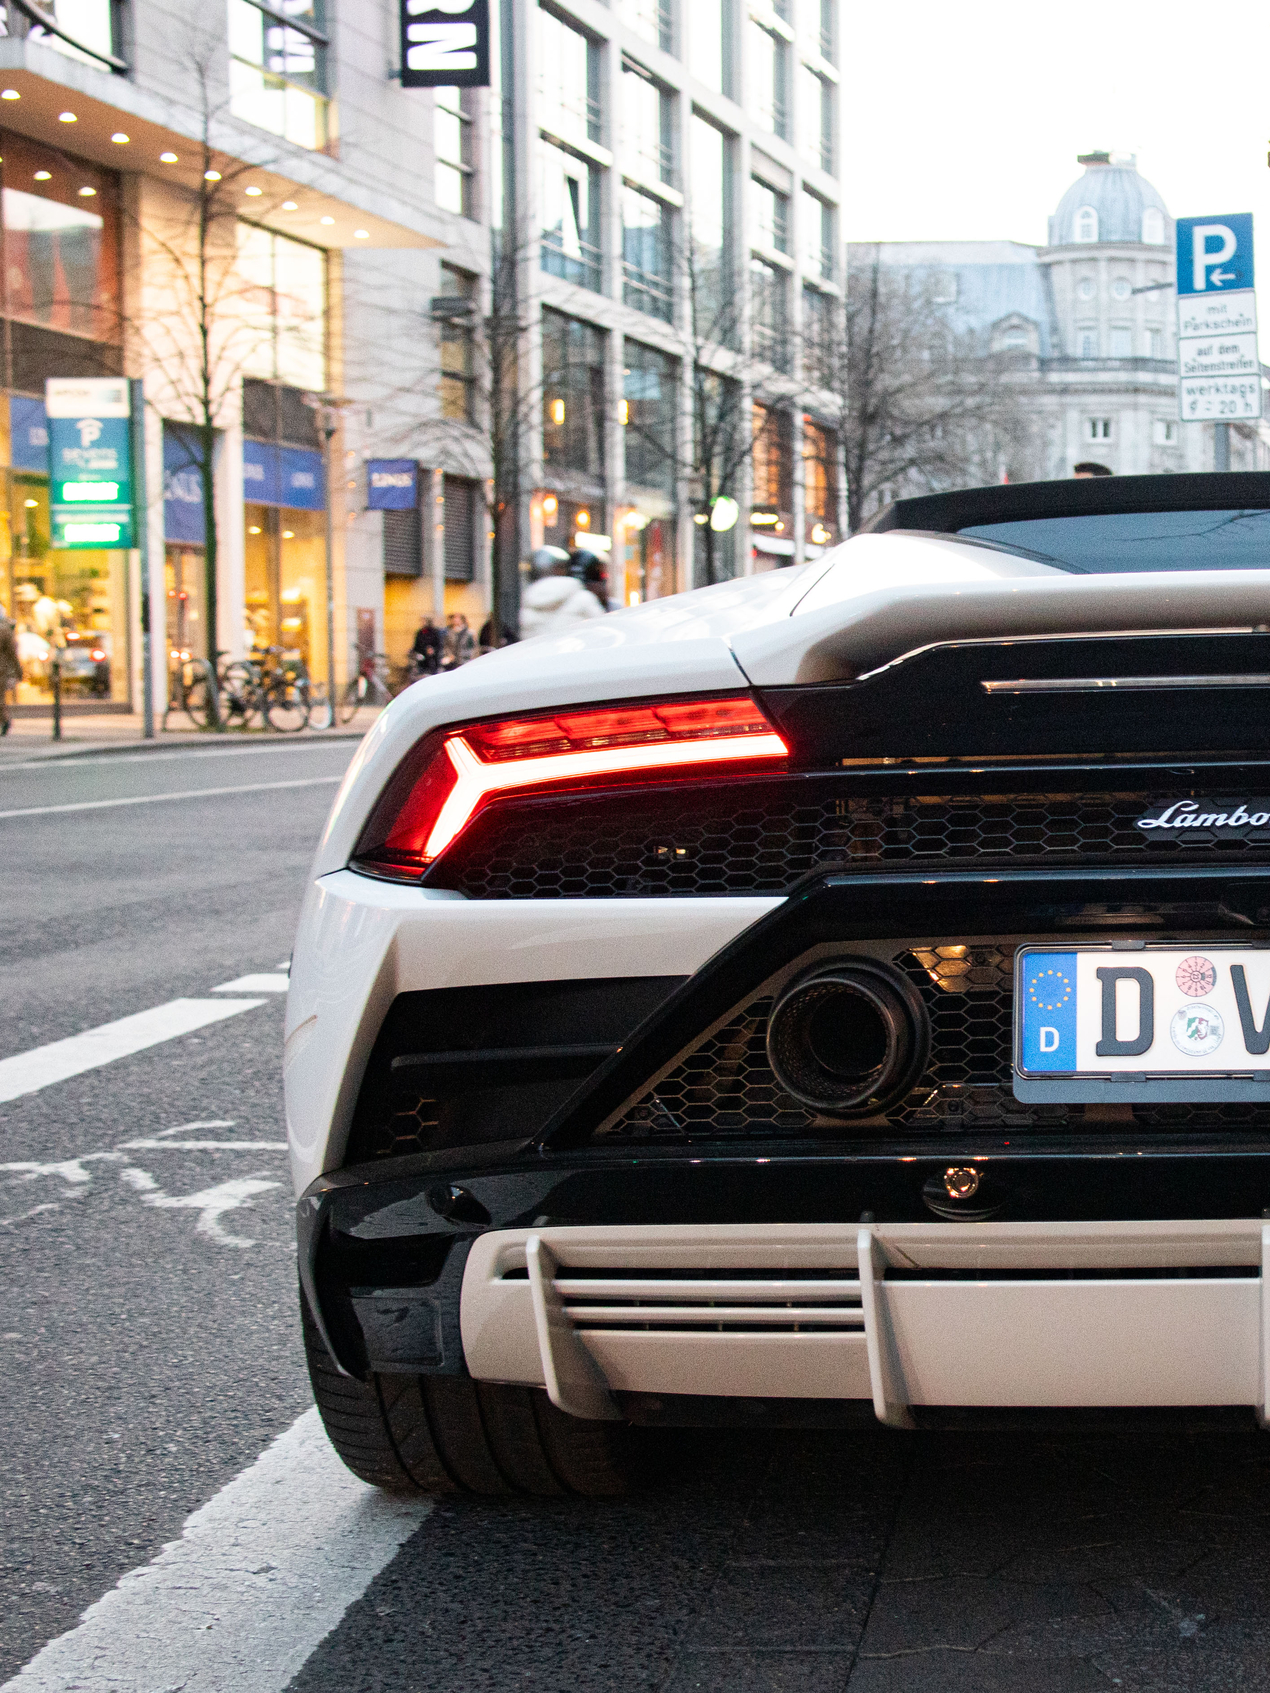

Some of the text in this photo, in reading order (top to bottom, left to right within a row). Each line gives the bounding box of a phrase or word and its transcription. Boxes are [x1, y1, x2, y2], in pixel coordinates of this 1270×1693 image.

[1192, 224, 1238, 291] P
[1206, 304, 1228, 314] mit
[1183, 317, 1253, 332] Parkschein
[1197, 344, 1240, 356] auf dem
[1184, 357, 1255, 374] Seitenstreifen
[1186, 383, 1256, 399] werktags
[1219, 400, 1237, 414] 20
[1244, 400, 1253, 413] h
[1095, 966, 1155, 1057] D
[1039, 1026, 1060, 1052] D
